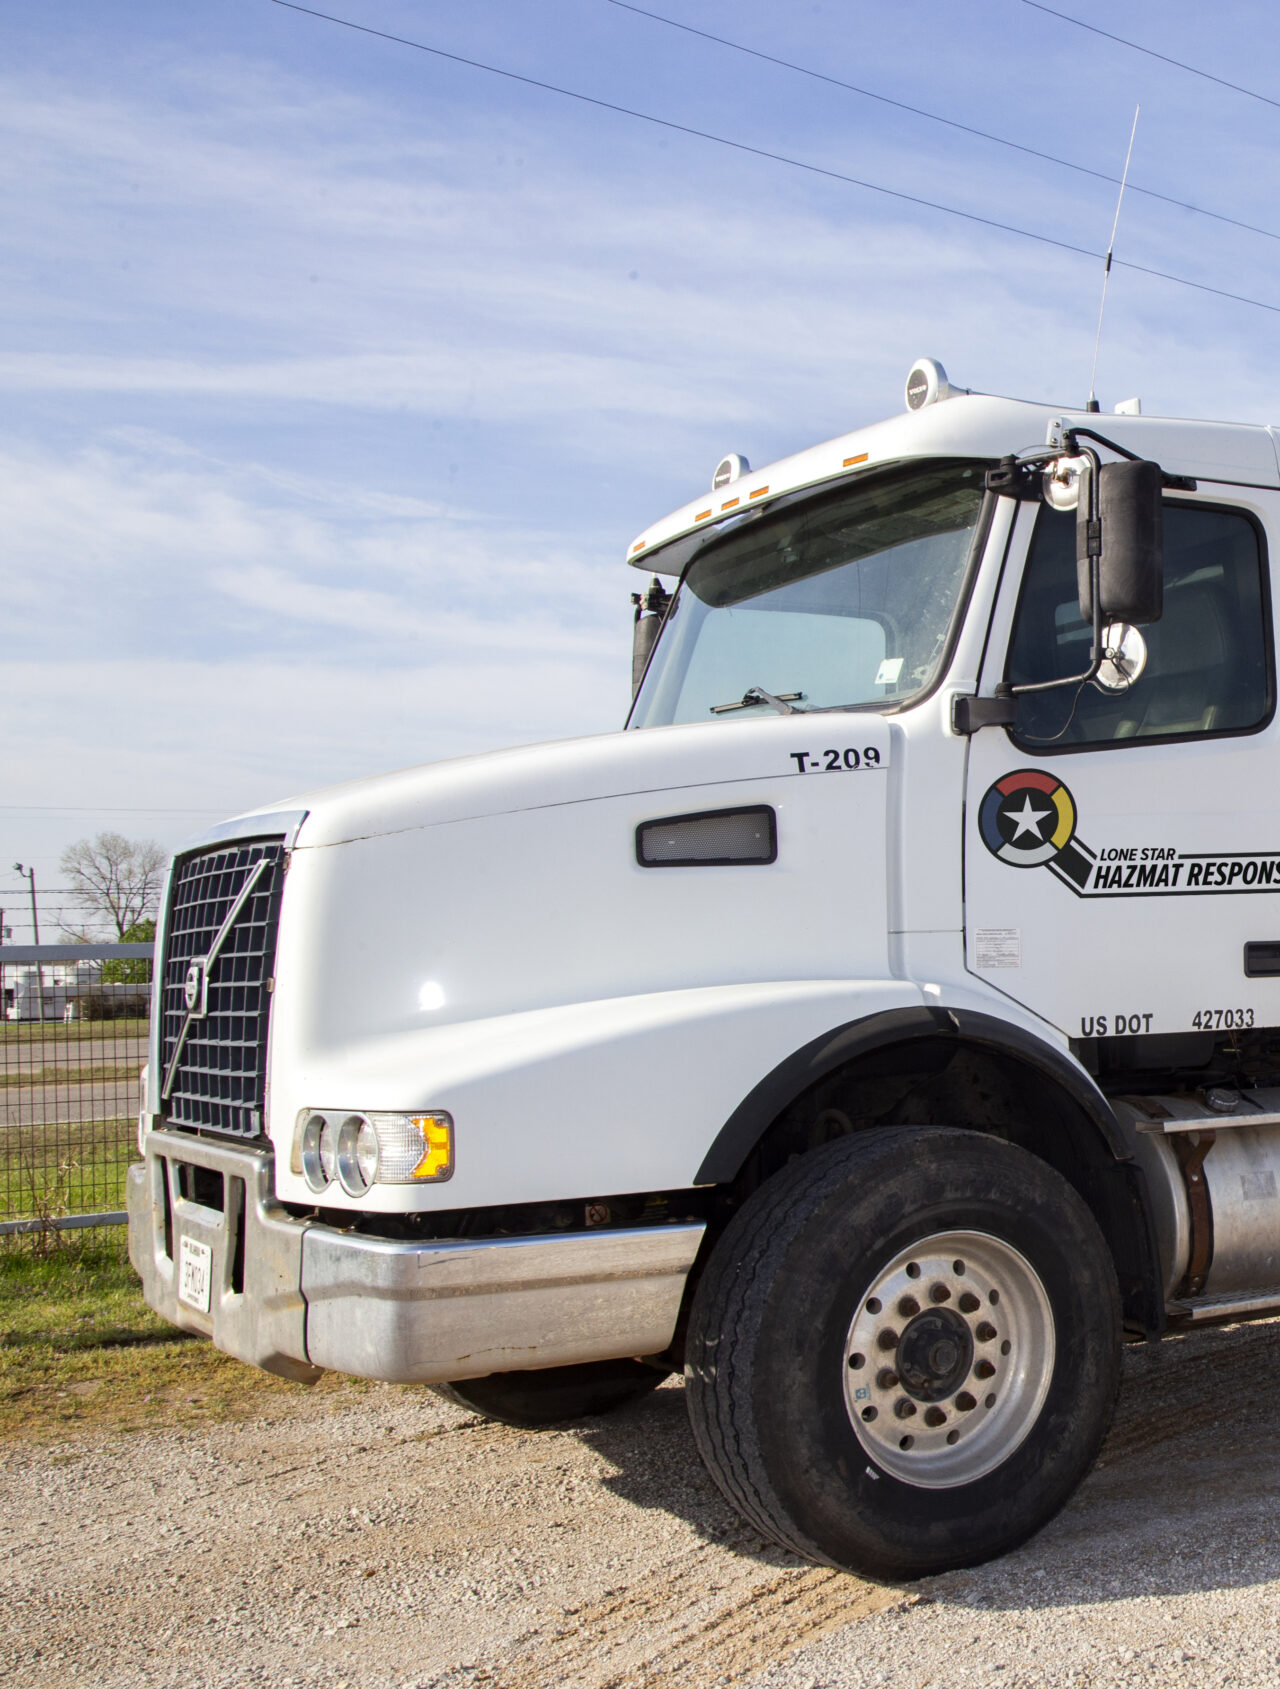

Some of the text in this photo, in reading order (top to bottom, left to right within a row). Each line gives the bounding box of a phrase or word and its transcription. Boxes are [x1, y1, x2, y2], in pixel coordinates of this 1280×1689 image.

[790, 747, 880, 772] T-209
[1100, 848, 1176, 861] LONE STAR
[1093, 863, 1184, 889] HAZMAT
[1081, 1008, 1254, 1037] US DOT 427033
